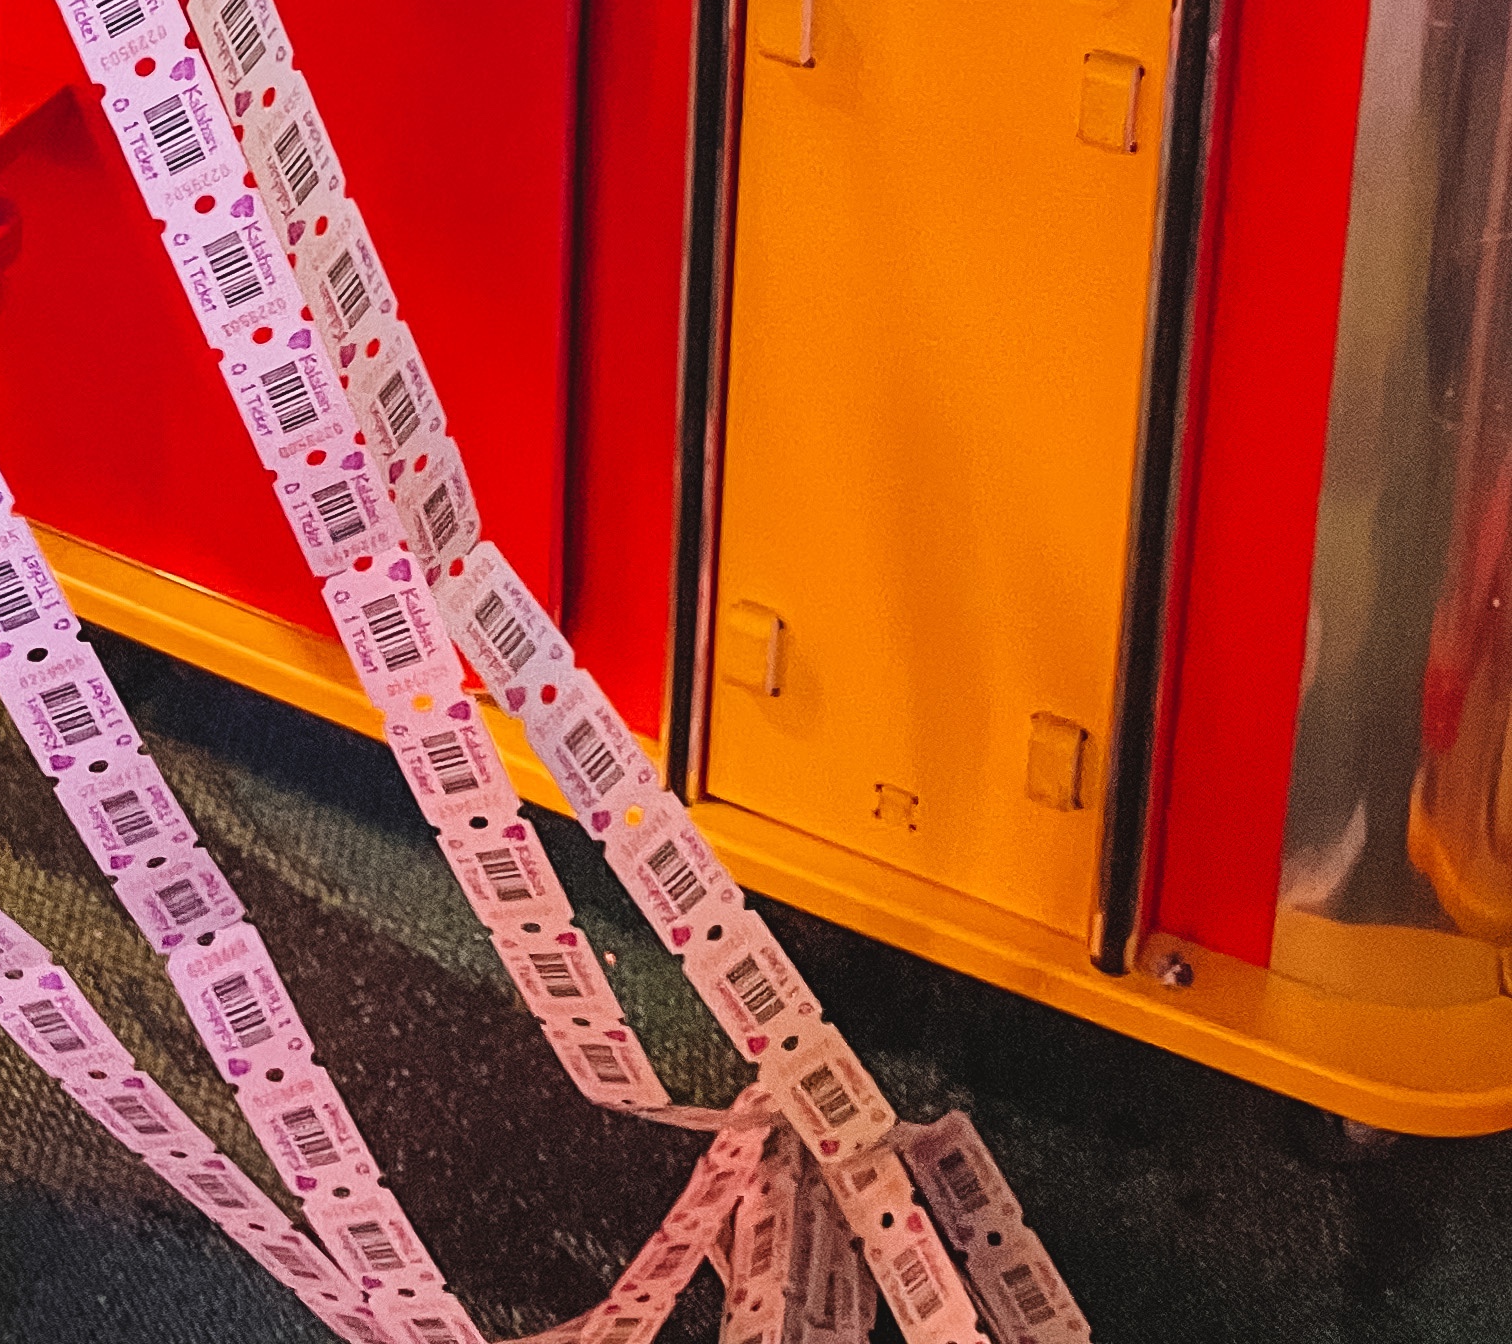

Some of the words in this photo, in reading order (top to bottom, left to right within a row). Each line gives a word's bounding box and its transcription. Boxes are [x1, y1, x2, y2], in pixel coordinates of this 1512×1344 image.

[123, 121, 139, 135] 1
[183, 82, 220, 156] Kalahari
[129, 134, 158, 183] Ticket
[182, 254, 199, 267] 1
[241, 218, 278, 289] Kalahari
[190, 269, 218, 314] Ticket
